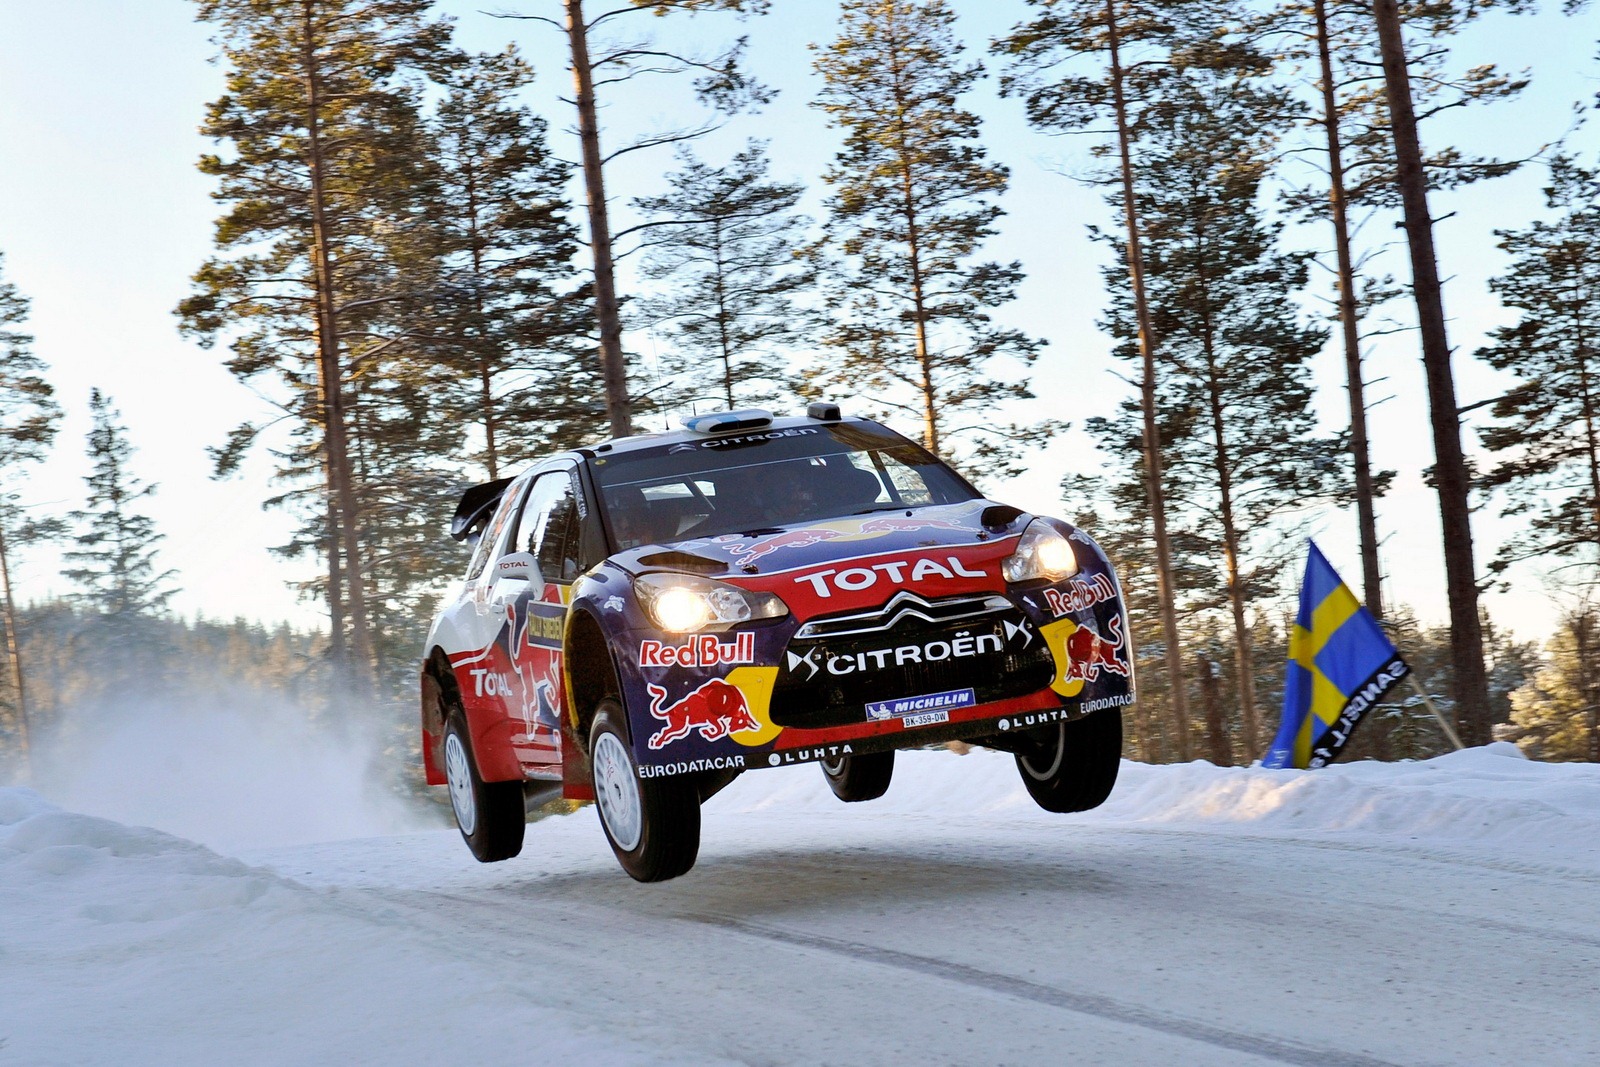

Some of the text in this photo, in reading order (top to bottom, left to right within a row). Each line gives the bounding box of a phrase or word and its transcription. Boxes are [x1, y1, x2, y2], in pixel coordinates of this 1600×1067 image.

[499, 561, 529, 570] TOTAL
[794, 557, 987, 598] TOTAL
[1043, 572, 1116, 617] Red Bull
[639, 632, 755, 667] Red Bull
[470, 668, 513, 697] TOTAL
[894, 693, 969, 712] MICHELIN
[1080, 691, 1136, 714] EURODATACA
[905, 713, 946, 727] BK-359-DW
[1013, 710, 1068, 727] LUHTA
[785, 744, 853, 762] LUHTA
[638, 755, 745, 778] EURODATACAR
